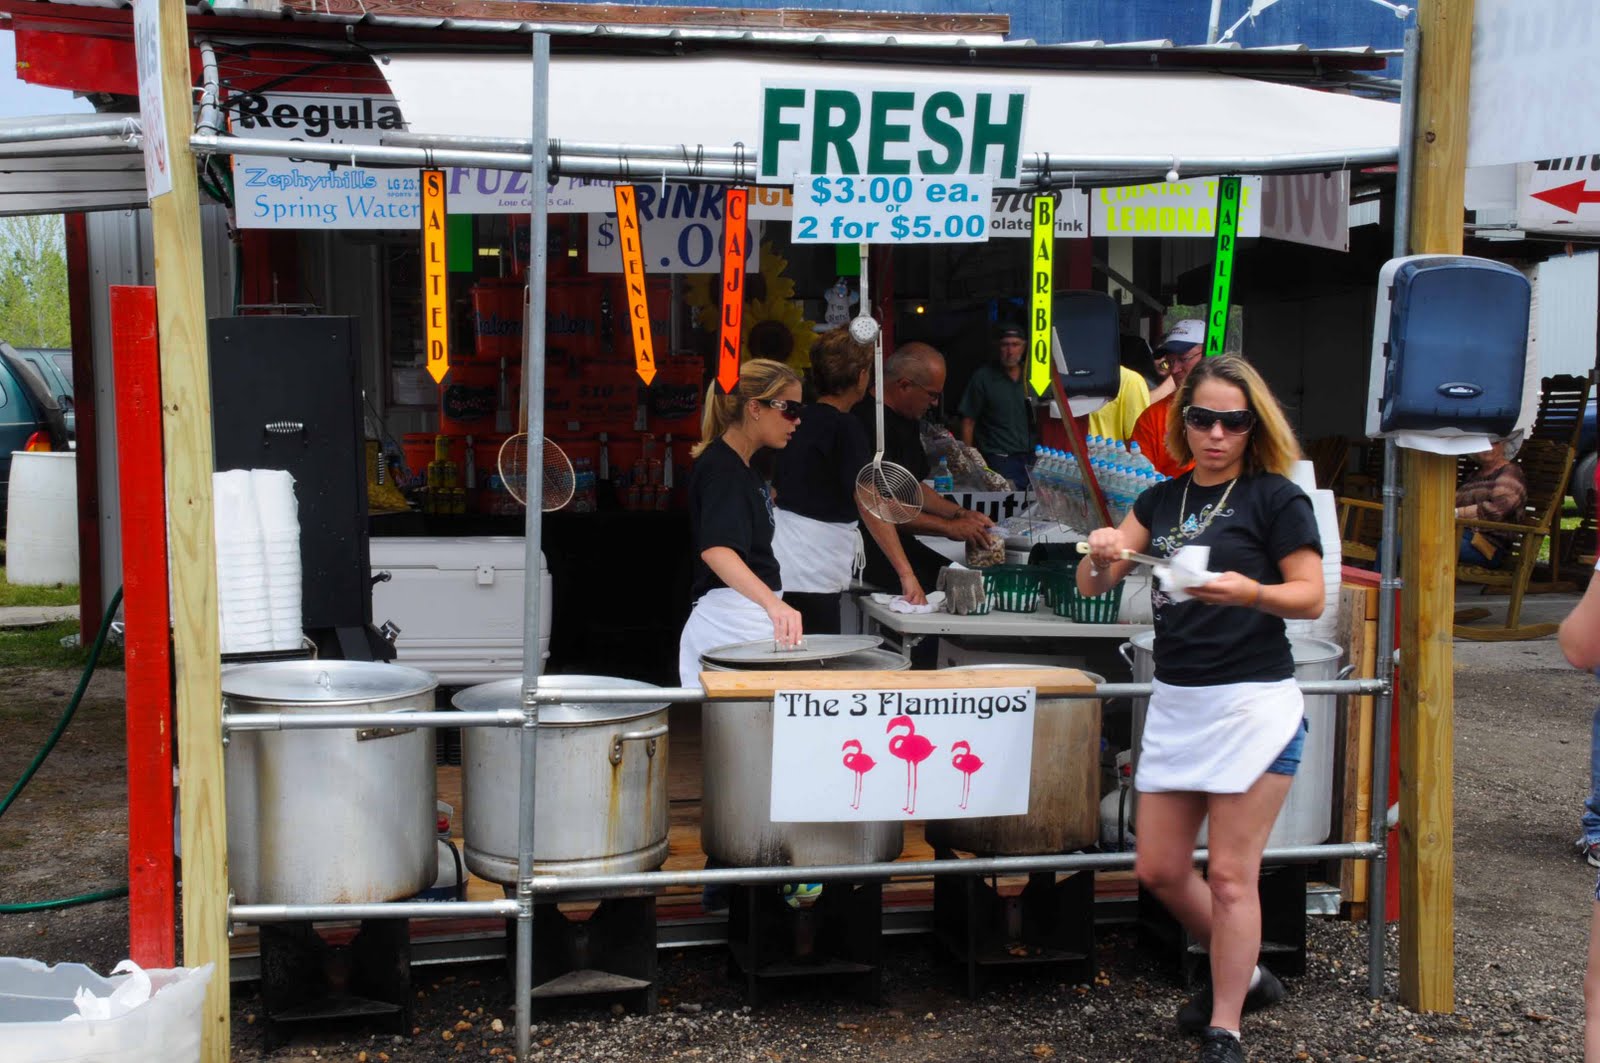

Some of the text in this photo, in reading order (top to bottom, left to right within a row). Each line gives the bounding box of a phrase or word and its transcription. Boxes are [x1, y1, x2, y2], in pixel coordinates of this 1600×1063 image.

[239, 94, 403, 137] Regula
[762, 88, 1025, 179] FRESH
[245, 168, 377, 191] Zephyrhills
[387, 178, 400, 190] LG
[811, 176, 913, 206] $3.00
[926, 183, 979, 203] ea.
[254, 194, 420, 223] Spring Water
[885, 203, 902, 213] or
[797, 215, 985, 240] 2 for $5.00
[427, 175, 443, 361] SALTED
[620, 191, 651, 363] VALENCIA
[723, 196, 742, 359] CAJUN
[780, 693, 839, 717] The
[849, 693, 868, 716] 3
